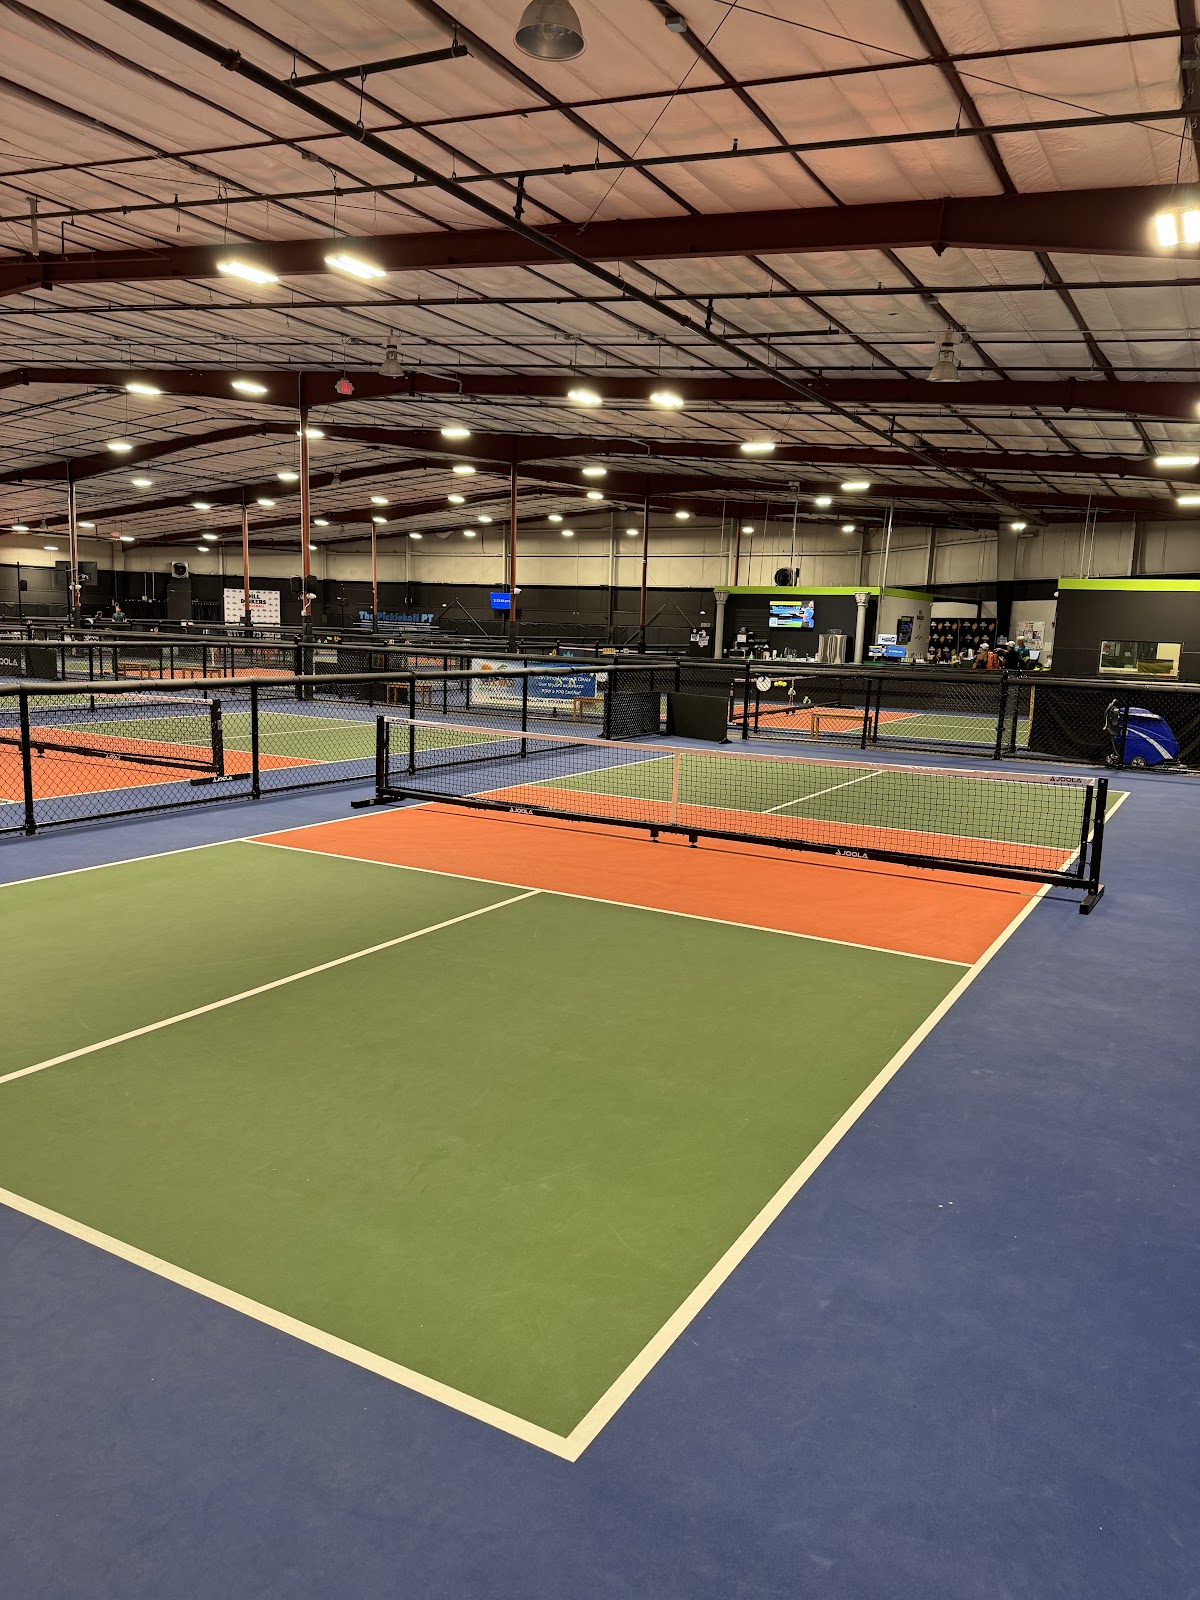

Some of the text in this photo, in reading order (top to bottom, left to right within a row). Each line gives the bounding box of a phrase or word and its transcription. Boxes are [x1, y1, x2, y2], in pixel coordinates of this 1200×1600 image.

[421, 613, 434, 622] PT
[0, 658, 18, 667] OOLA
[841, 850, 868, 859] JOOLA
